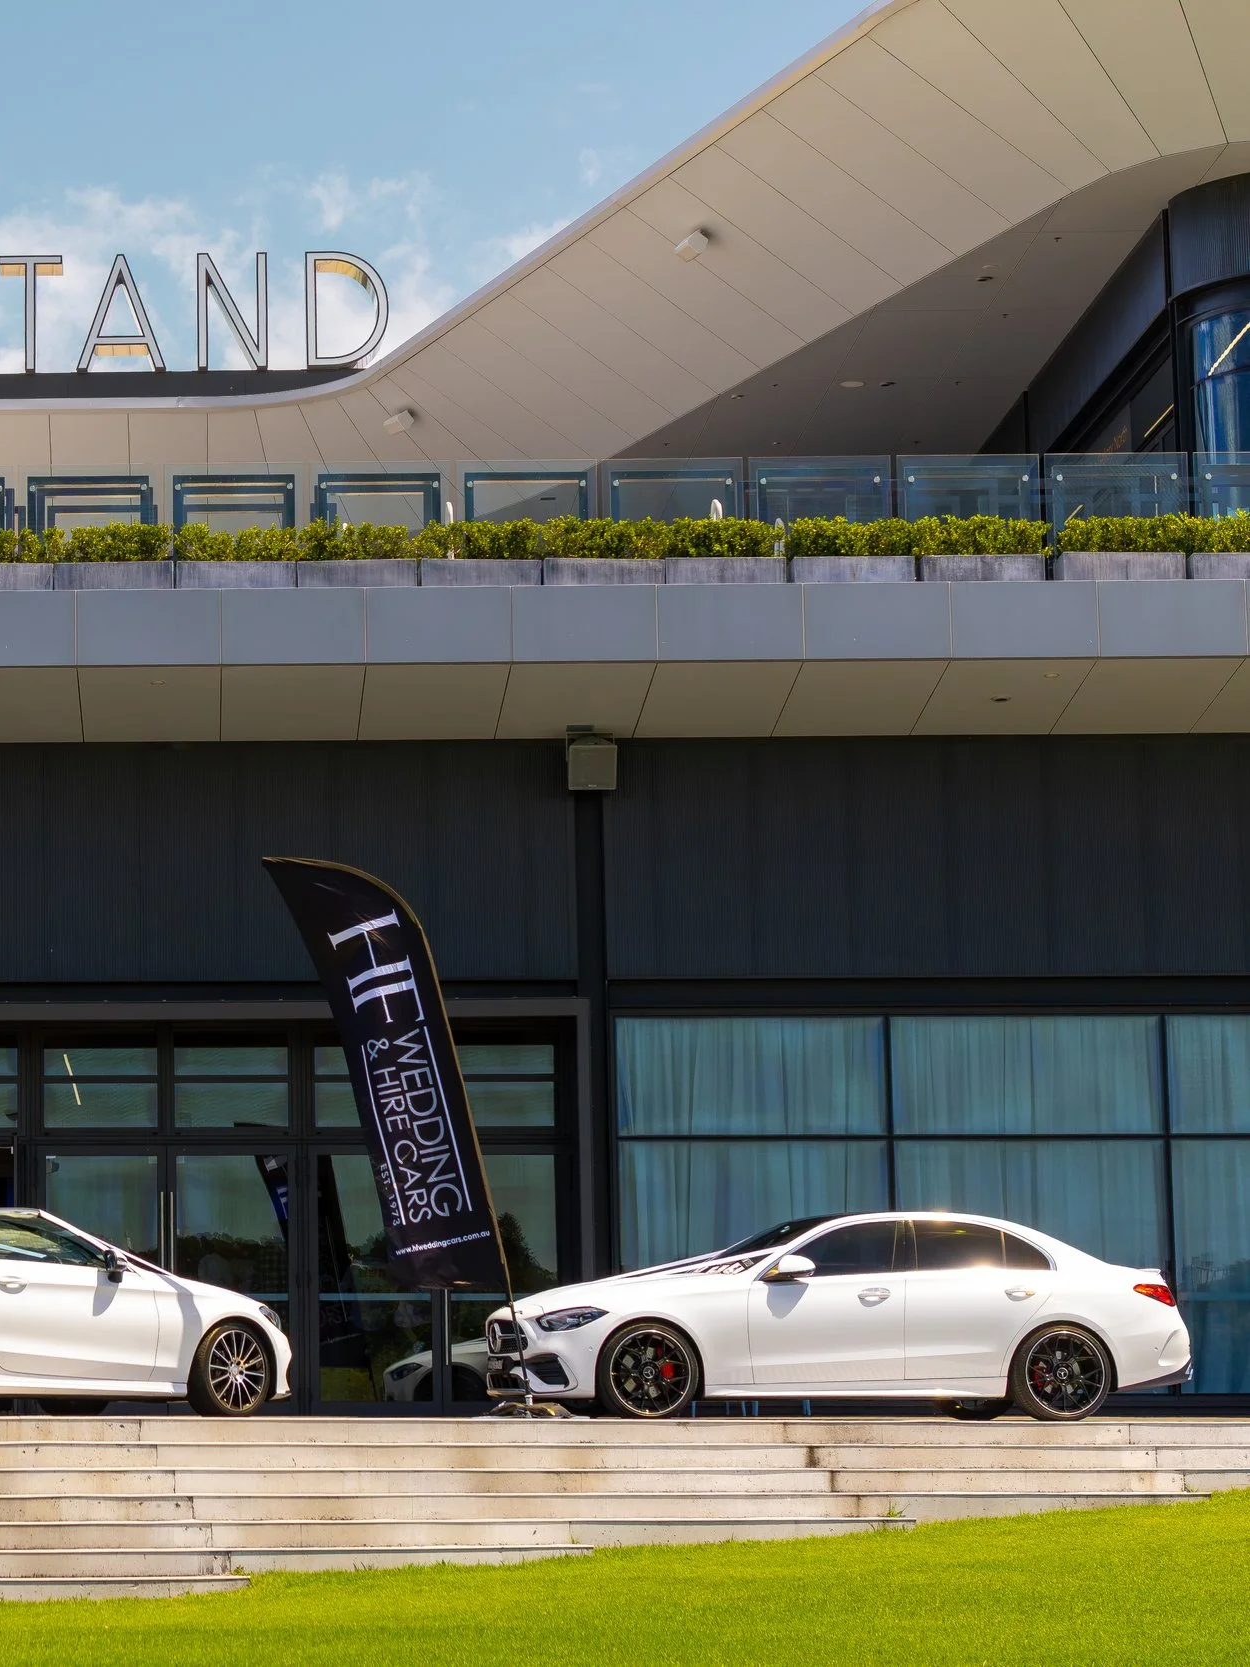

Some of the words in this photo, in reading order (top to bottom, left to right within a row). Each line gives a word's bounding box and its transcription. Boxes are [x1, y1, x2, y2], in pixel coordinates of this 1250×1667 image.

[327, 908, 425, 1024] HF
[366, 1037, 390, 1062] &
[373, 1066, 411, 1133] HIRE
[393, 1027, 463, 1217] WEDDING
[388, 1193, 401, 1226] 1973
[393, 1139, 433, 1224] CARS
